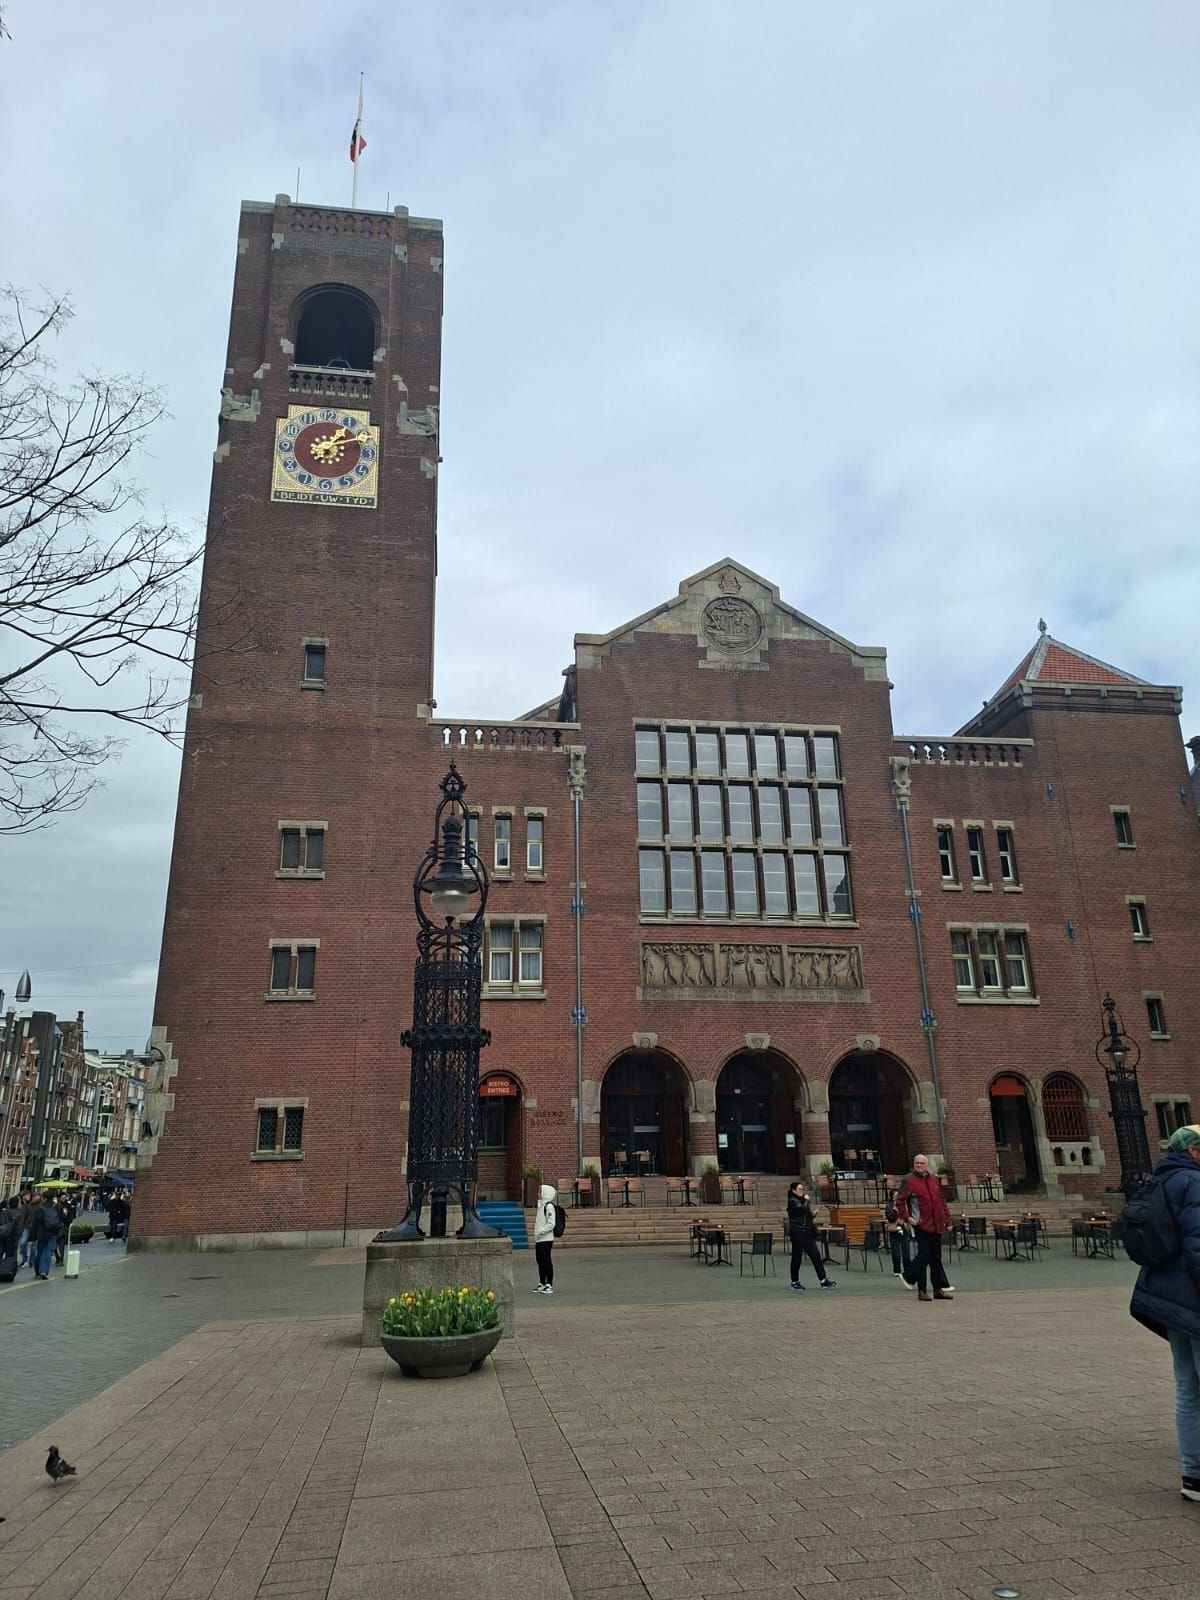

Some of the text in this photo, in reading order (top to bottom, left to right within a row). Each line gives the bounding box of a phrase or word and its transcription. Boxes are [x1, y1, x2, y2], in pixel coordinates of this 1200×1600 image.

[304, 413, 314, 424] 11
[323, 410, 335, 418] 12
[286, 424, 297, 434] 10
[281, 441, 290, 452] 9
[365, 448, 373, 459] 3
[286, 459, 294, 470] 8
[358, 465, 367, 475] 4
[300, 474, 309, 484] 7
[343, 476, 351, 487] 5
[321, 480, 330, 490] 6
